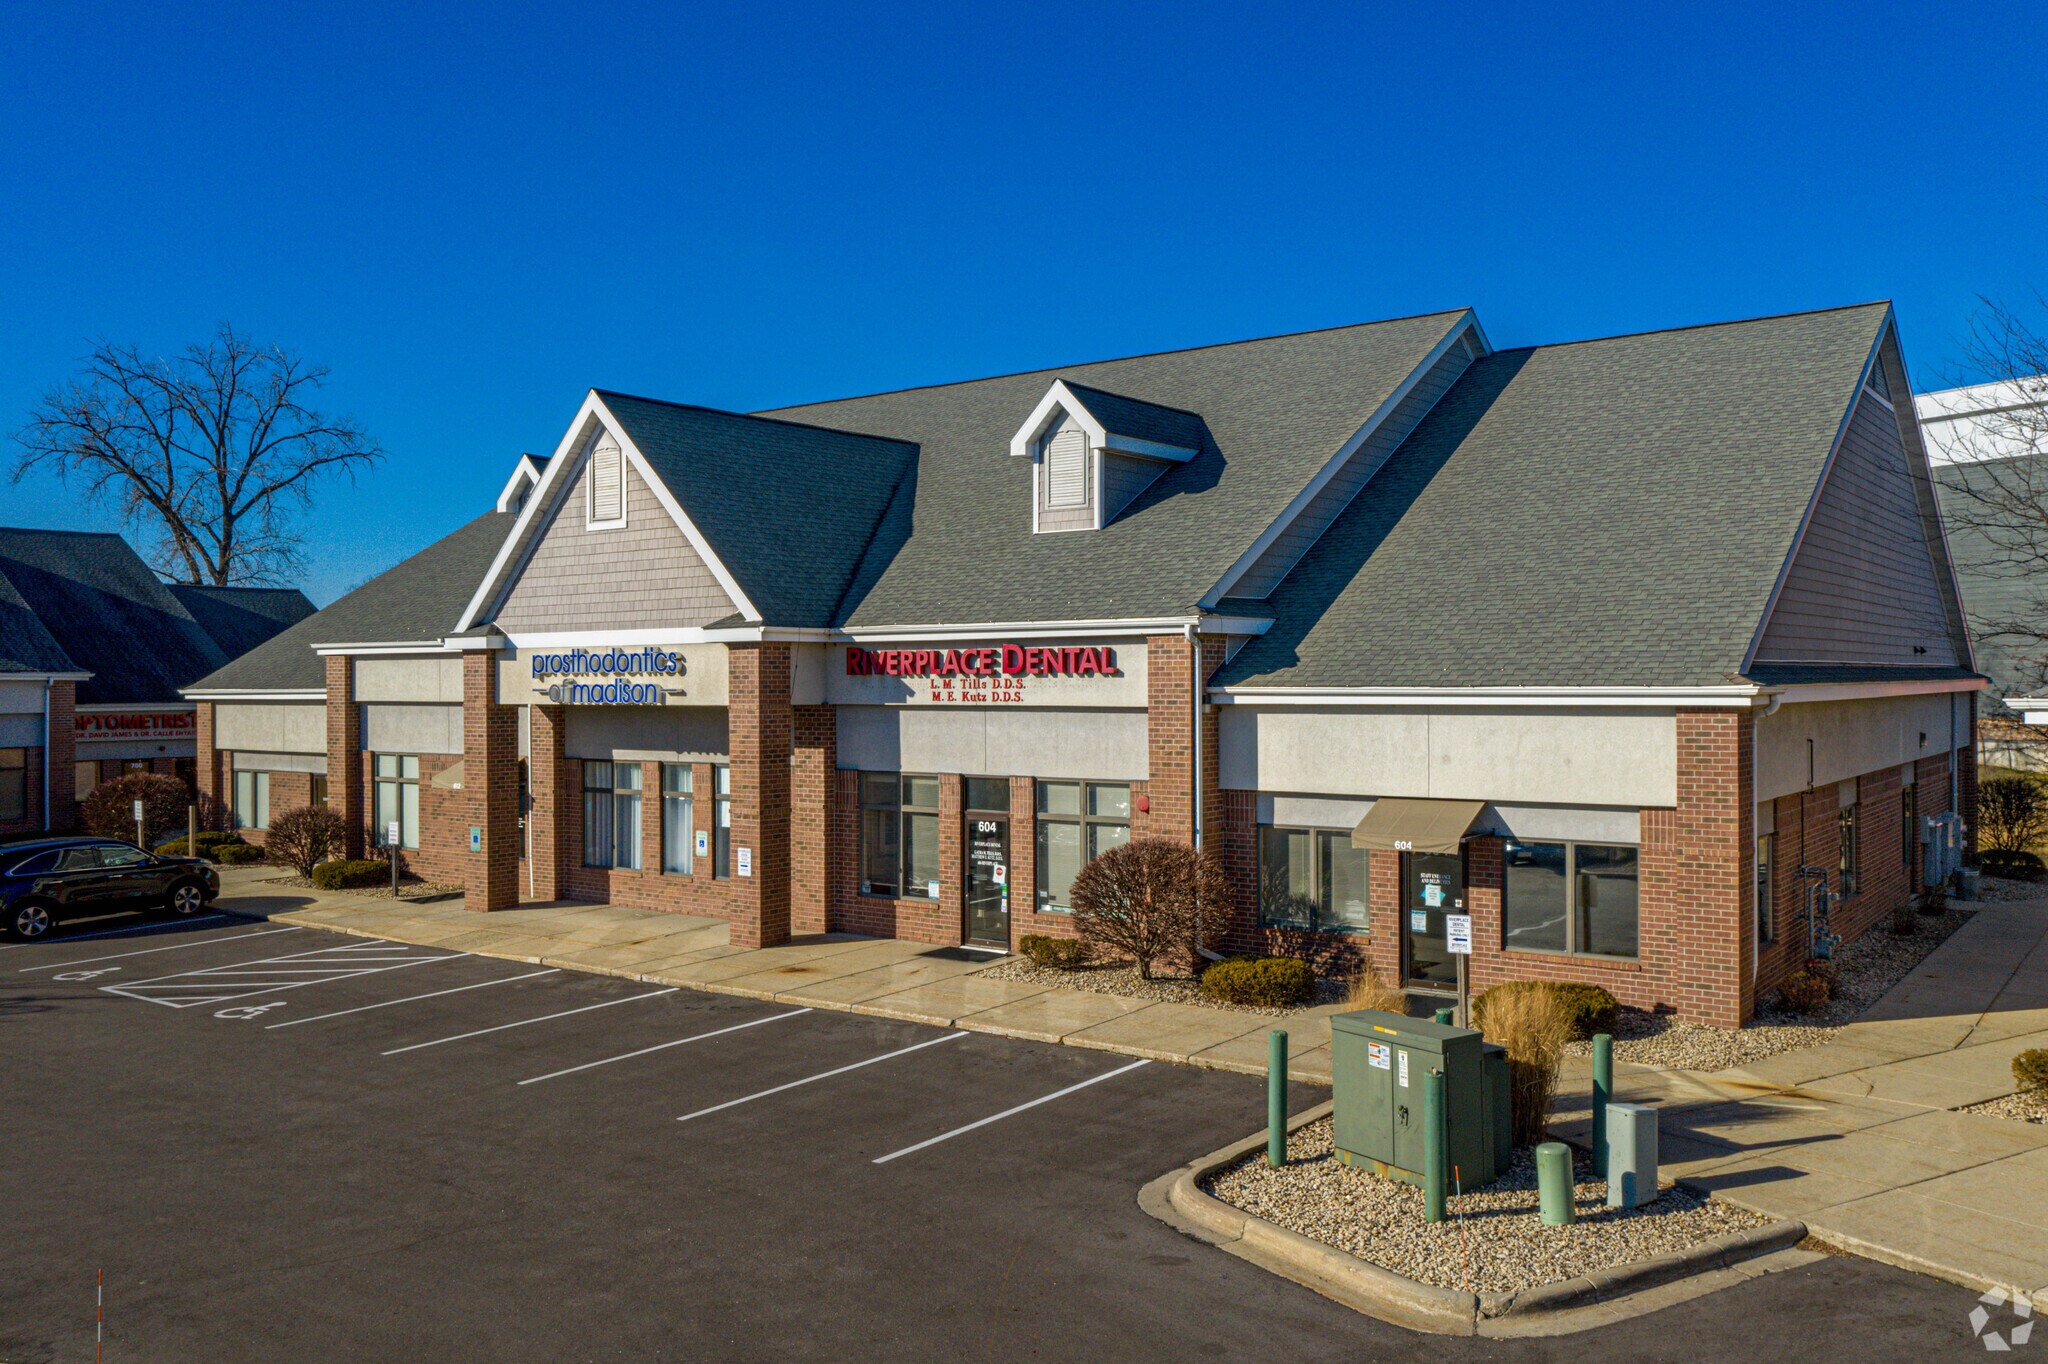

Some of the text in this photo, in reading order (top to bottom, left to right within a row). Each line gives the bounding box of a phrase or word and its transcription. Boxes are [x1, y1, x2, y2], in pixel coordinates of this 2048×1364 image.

[532, 647, 677, 678] prosthodontics
[846, 643, 1117, 675] RIVERPLACE DENTAL
[930, 679, 1026, 689] L. M. Tills D.D.S.
[549, 678, 657, 703] of madison
[932, 691, 1024, 702] M. E. Kutz D.D.S.
[978, 821, 996, 832] 604
[1394, 840, 1412, 850] 604
